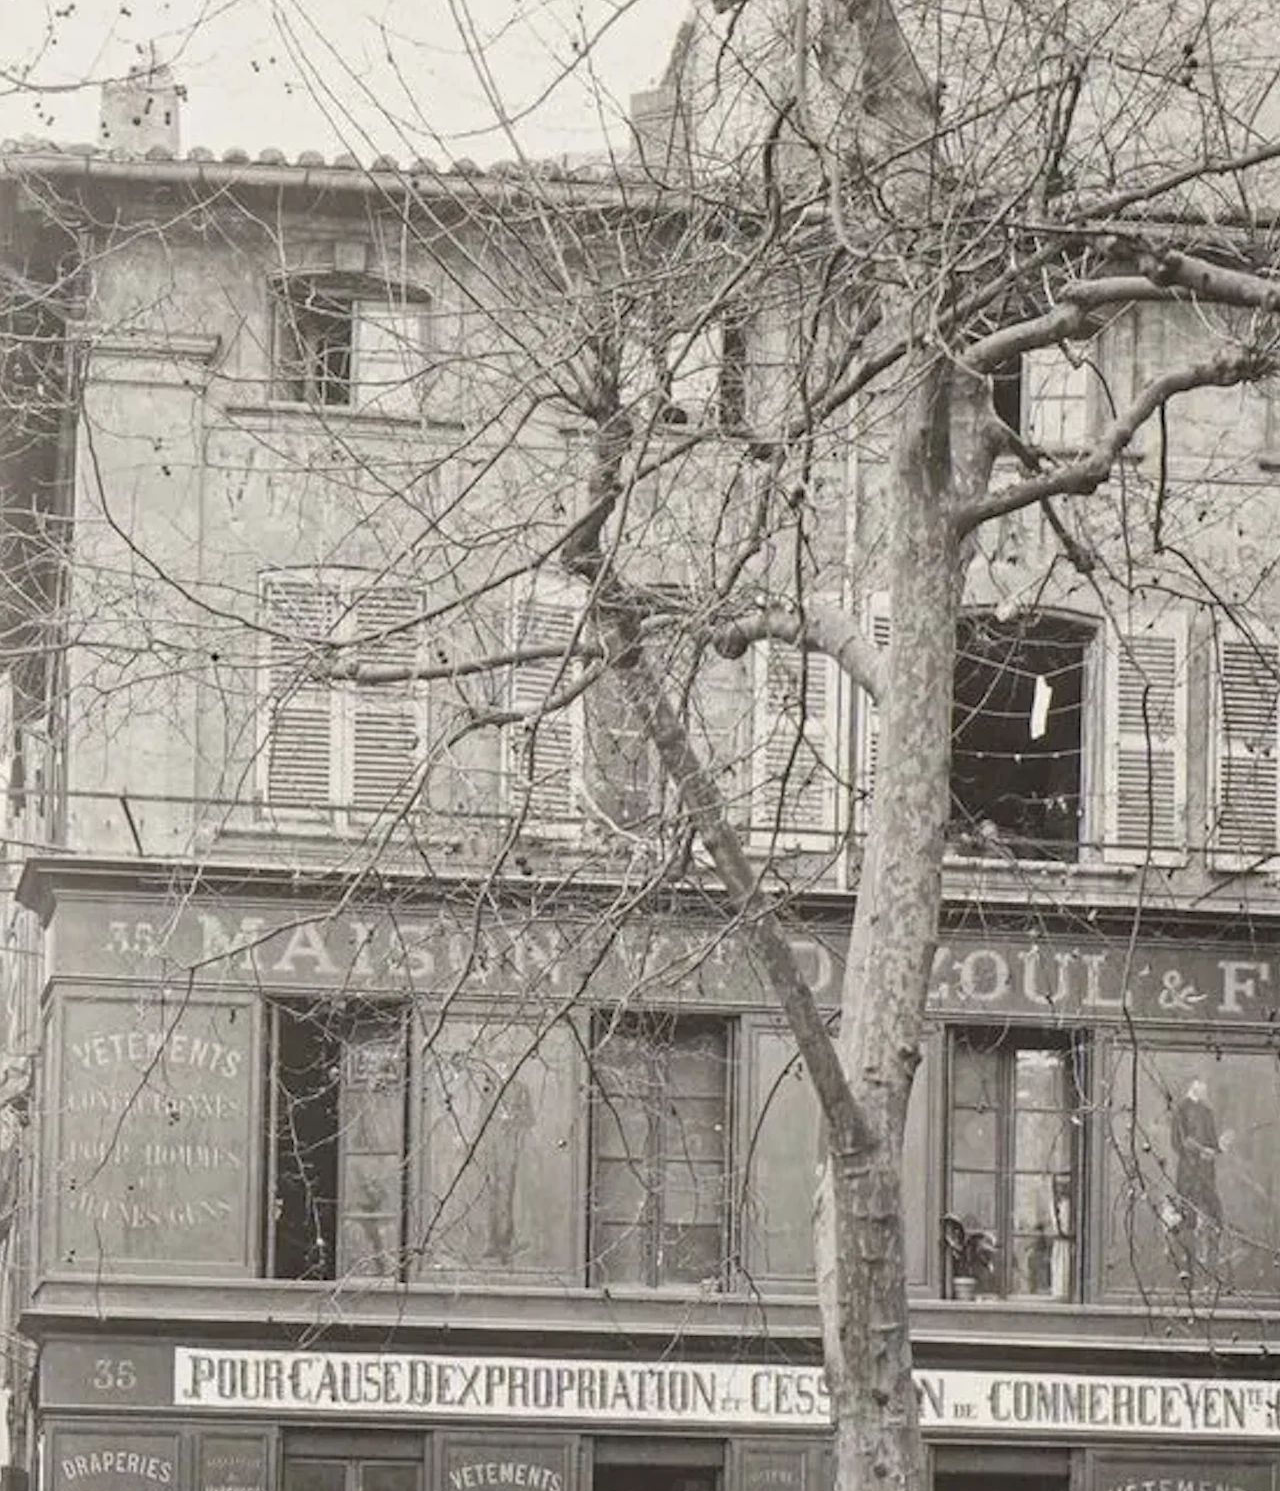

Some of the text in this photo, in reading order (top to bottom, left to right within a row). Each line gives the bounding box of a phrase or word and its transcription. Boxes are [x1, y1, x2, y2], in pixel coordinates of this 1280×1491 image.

[1158, 969, 1208, 1010] &
[287, 1360, 402, 1404] CAUSE
[751, 1370, 946, 1419] CESSN
[988, 1379, 1182, 1428] COMMERCE
[61, 1452, 173, 1484] DRAPERIES
